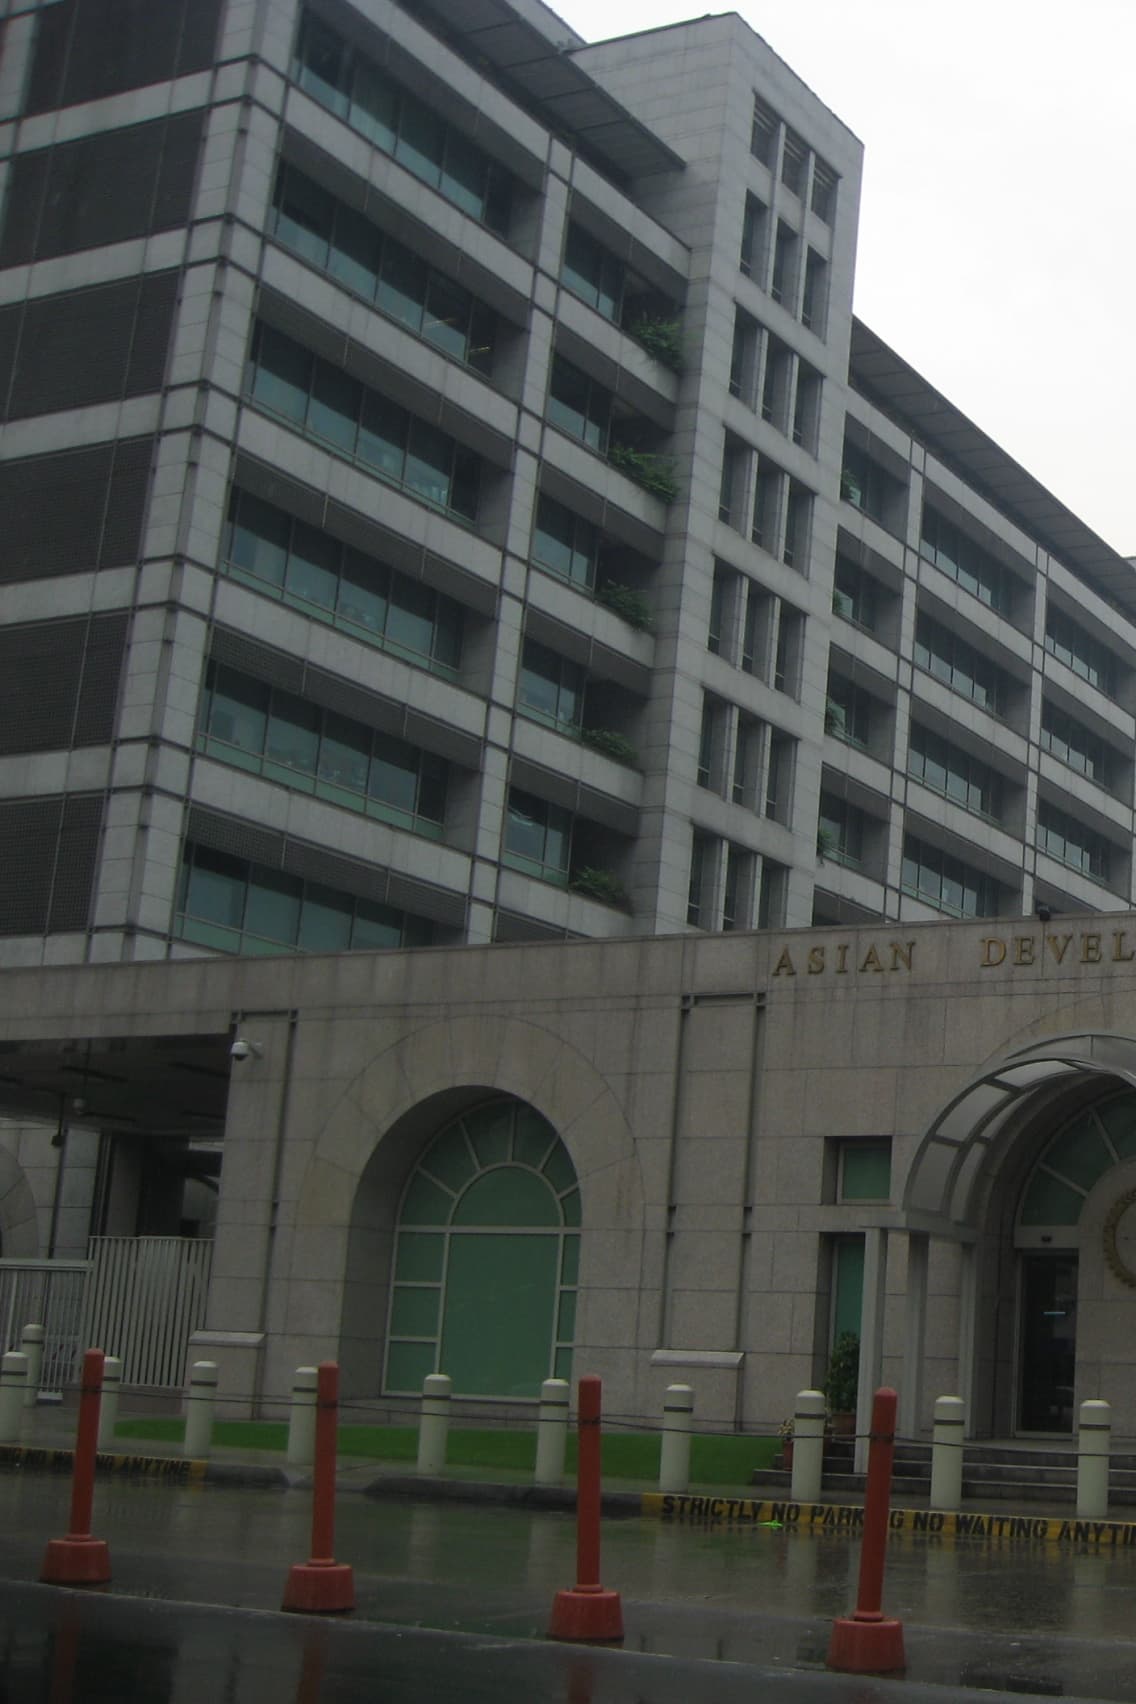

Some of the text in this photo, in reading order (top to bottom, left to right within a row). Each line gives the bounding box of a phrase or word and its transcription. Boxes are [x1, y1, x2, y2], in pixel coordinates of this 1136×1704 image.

[772, 942, 916, 976] ASIAN
[661, 1495, 764, 1521] STRICTLY
[771, 1502, 800, 1523] NO
[809, 1505, 905, 1529] PARKG
[913, 1511, 945, 1532] NO
[955, 1513, 1048, 1539] WAITING
